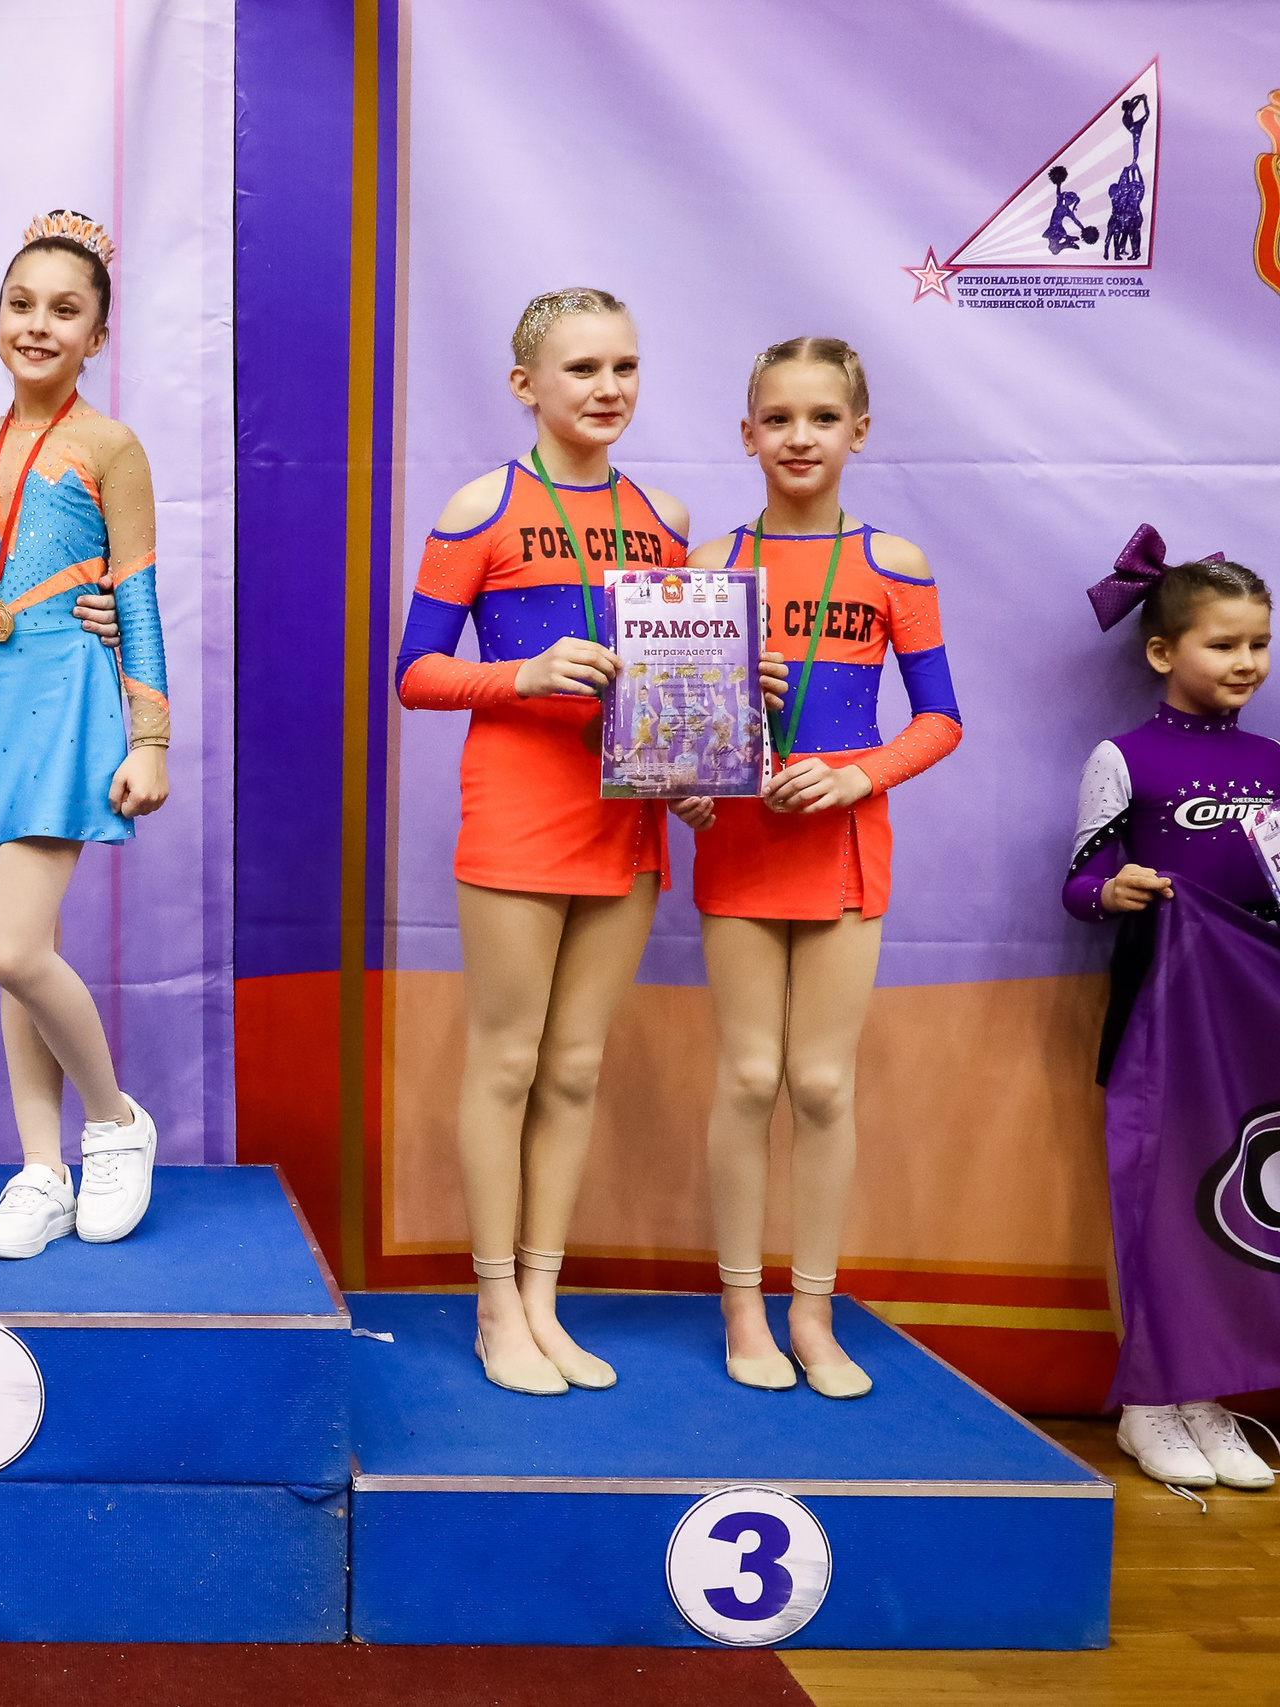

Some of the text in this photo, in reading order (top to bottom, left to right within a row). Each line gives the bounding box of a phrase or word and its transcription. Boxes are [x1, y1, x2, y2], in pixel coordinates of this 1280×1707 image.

[957, 276, 1143, 286] РЕГИОНАЛЬНОЕ ОТДЕЛЕНИЕ СОЮЗА
[957, 288, 1150, 298] ЧИР СПОРТА И ЧИРЛИДИНГА РОССИИ
[958, 298, 1096, 309] В ЧЕЛЯБИНСКОЙ ОБЛАСТИ
[519, 526, 663, 568] FOR CHEER
[784, 600, 876, 643] CHEER
[624, 620, 741, 638] ГРАМОТА
[643, 648, 723, 657] награждается
[702, 1511, 794, 1622] 3
